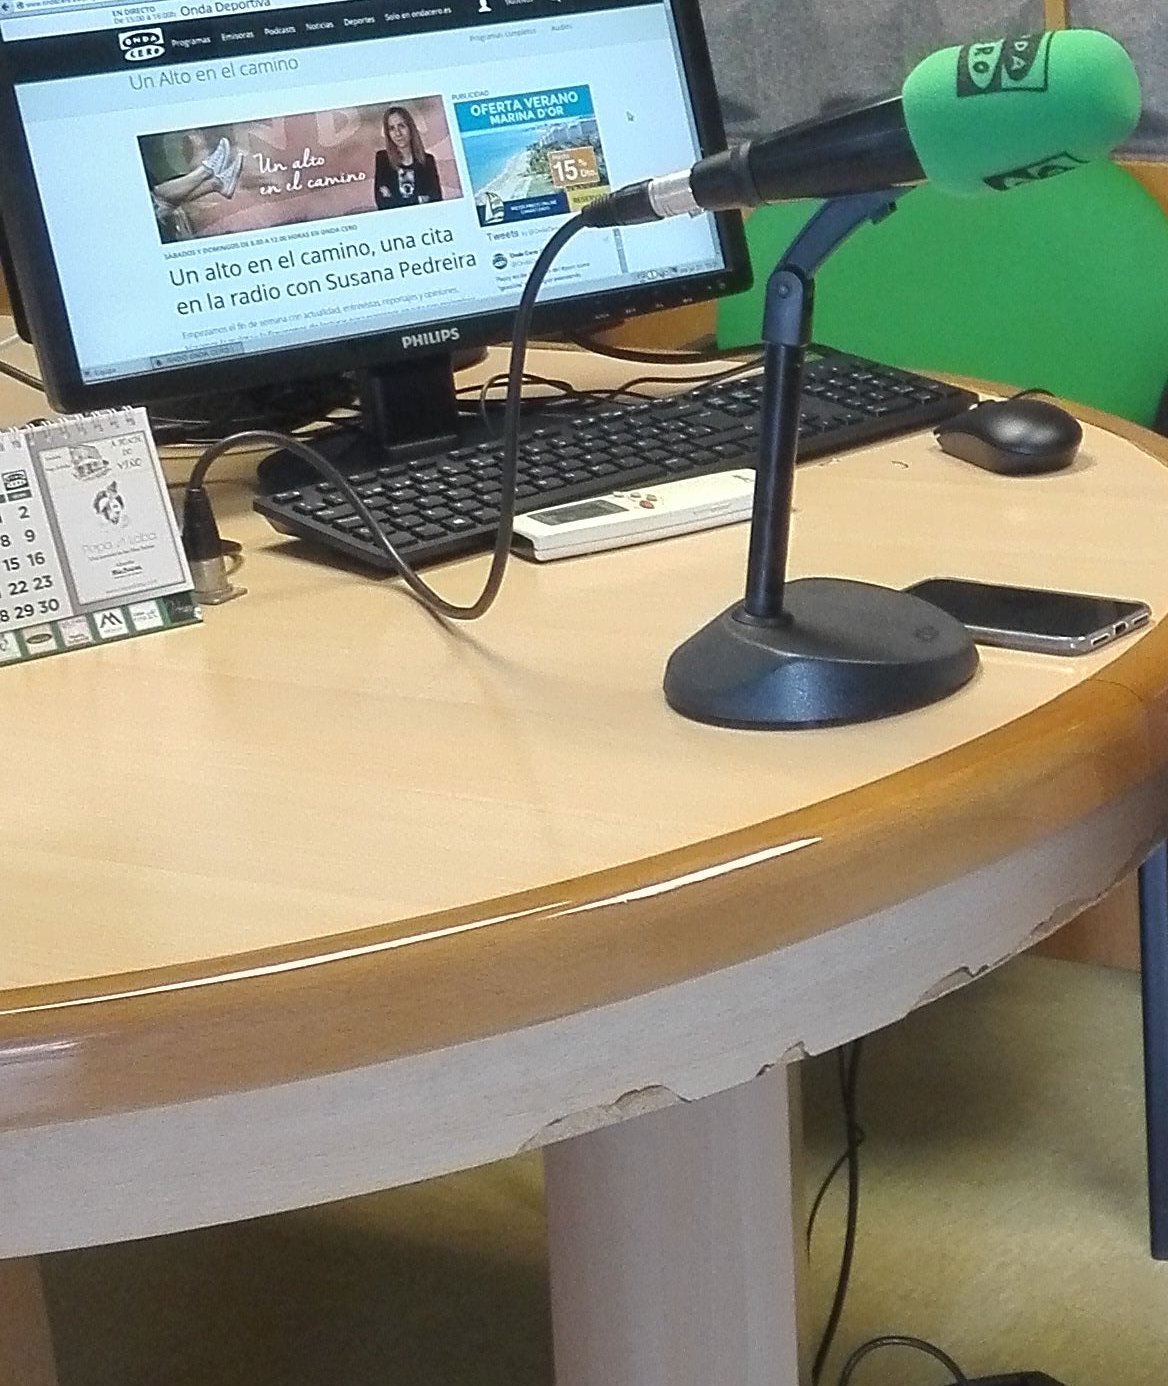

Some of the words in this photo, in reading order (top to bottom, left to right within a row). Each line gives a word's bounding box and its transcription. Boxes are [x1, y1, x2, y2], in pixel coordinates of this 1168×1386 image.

[123, 6, 156, 17] DIRECTO
[180, 5, 212, 17] Onda
[384, 12, 400, 22] Solo
[401, 12, 411, 21] en
[305, 21, 334, 31] Noticias
[343, 16, 376, 27] Deportes
[221, 31, 254, 43] Emisoras
[264, 25, 296, 37] Podcasts
[124, 33, 158, 47] ONDA
[172, 35, 211, 49] Programas
[130, 46, 160, 59] CERO
[130, 75, 154, 91] Un
[159, 71, 192, 87] Alto
[196, 69, 216, 83] en
[222, 63, 235, 79] el
[240, 57, 299, 77] camino
[451, 89, 490, 101] PUBLICIDAD
[470, 100, 522, 117] OFERTA
[524, 91, 579, 109] VERANO
[490, 110, 536, 126] MARINA
[537, 105, 564, 119] D'OR
[252, 153, 288, 175] Un
[292, 147, 326, 171] alto
[553, 159, 578, 183] 15
[260, 181, 282, 197] en
[286, 171, 303, 192] el
[308, 171, 366, 190] camino
[486, 230, 520, 243] Tweets
[170, 269, 199, 287] Un
[205, 260, 242, 282] alto
[248, 255, 272, 274] en
[278, 250, 296, 269] el
[301, 239, 376, 267] camino,
[381, 235, 416, 255] una
[421, 227, 454, 246] cita
[177, 298, 202, 316] en
[208, 291, 224, 311] la
[230, 279, 281, 307] radio
[286, 278, 321, 298] con
[327, 266, 394, 291] Susana
[399, 251, 477, 279] Pedreira
[402, 327, 460, 349] PHILIPS
[18, 506, 30, 519] 2
[0, 534, 11, 547] 8
[24, 529, 36, 543] 9
[3, 557, 20, 572] 15
[26, 551, 46, 567] 16
[8, 580, 29, 596] 22
[33, 575, 53, 591] 23
[14, 603, 35, 620] 29
[38, 598, 60, 614] 30
